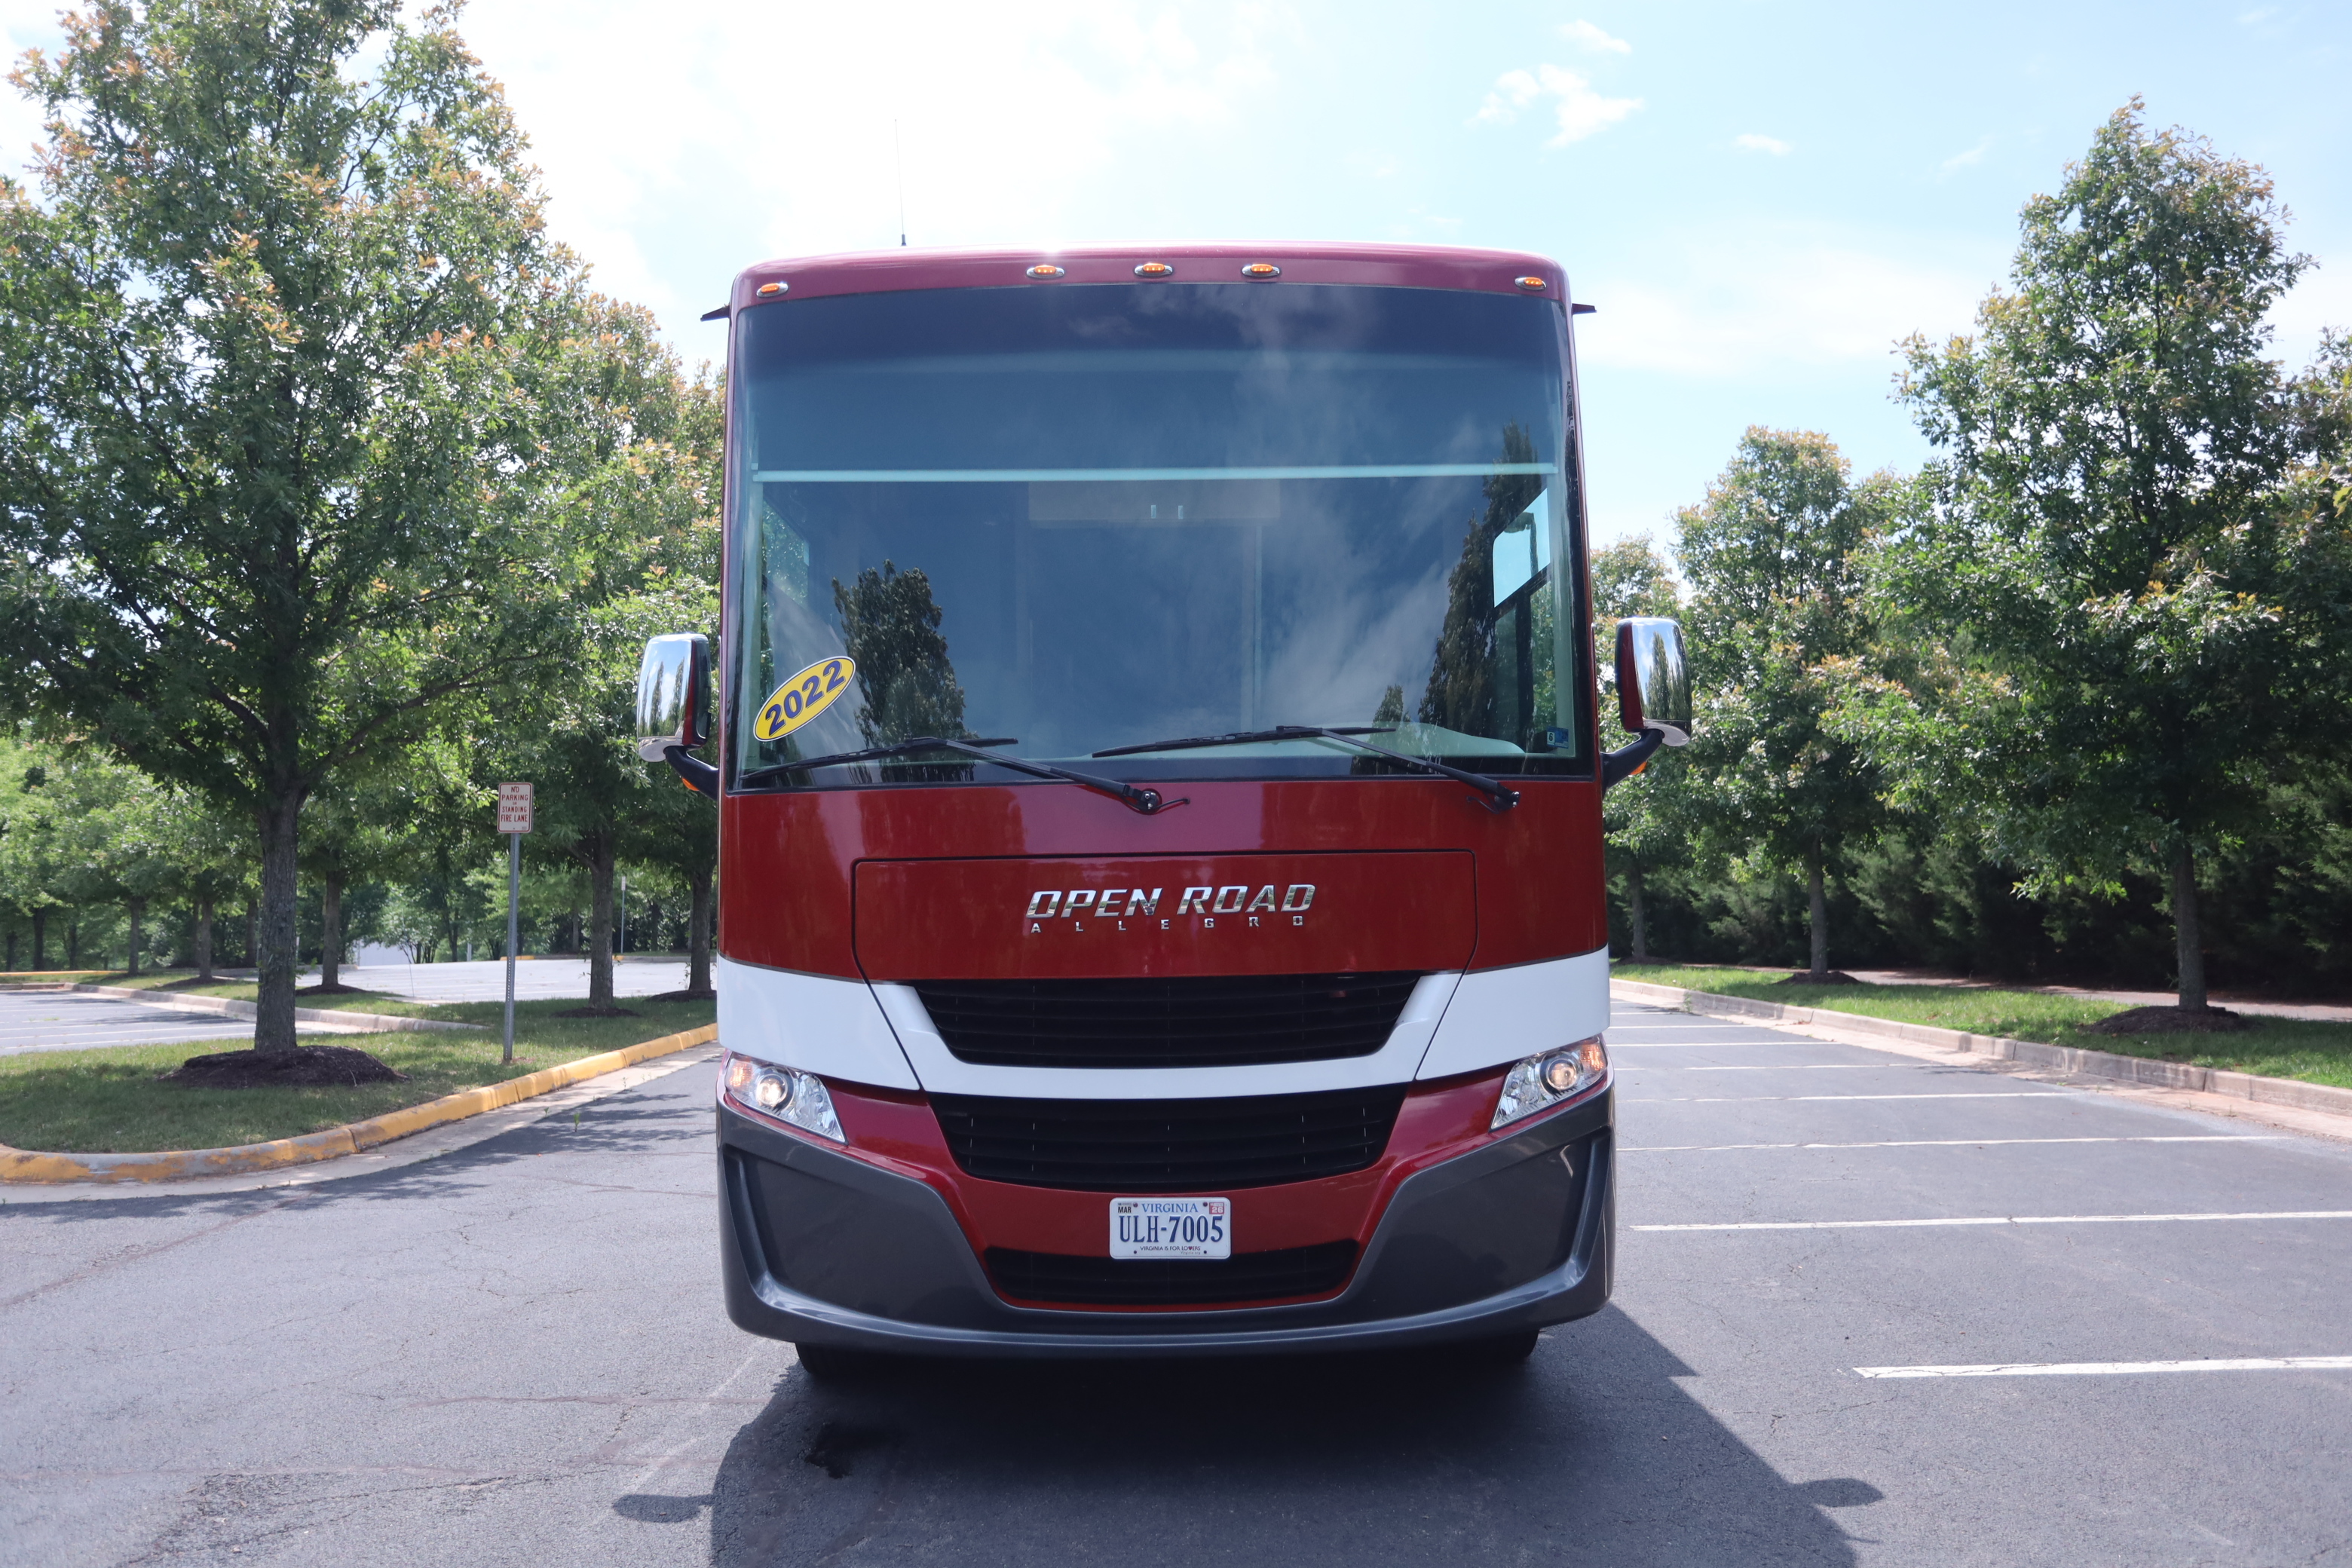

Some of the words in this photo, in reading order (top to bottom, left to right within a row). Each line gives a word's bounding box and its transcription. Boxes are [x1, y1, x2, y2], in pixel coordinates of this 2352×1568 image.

[765, 660, 846, 737] 2022
[1549, 733, 1553, 741] 6
[501, 814, 512, 822] FIRE
[514, 814, 528, 822] LANE
[1025, 887, 1163, 919] OPEN
[1176, 884, 1316, 916] ROAD
[1030, 915, 1303, 934] ALLEGRO
[1141, 1203, 1199, 1213] VIRGINIA
[1119, 1215, 1223, 1242] ULH-7005
